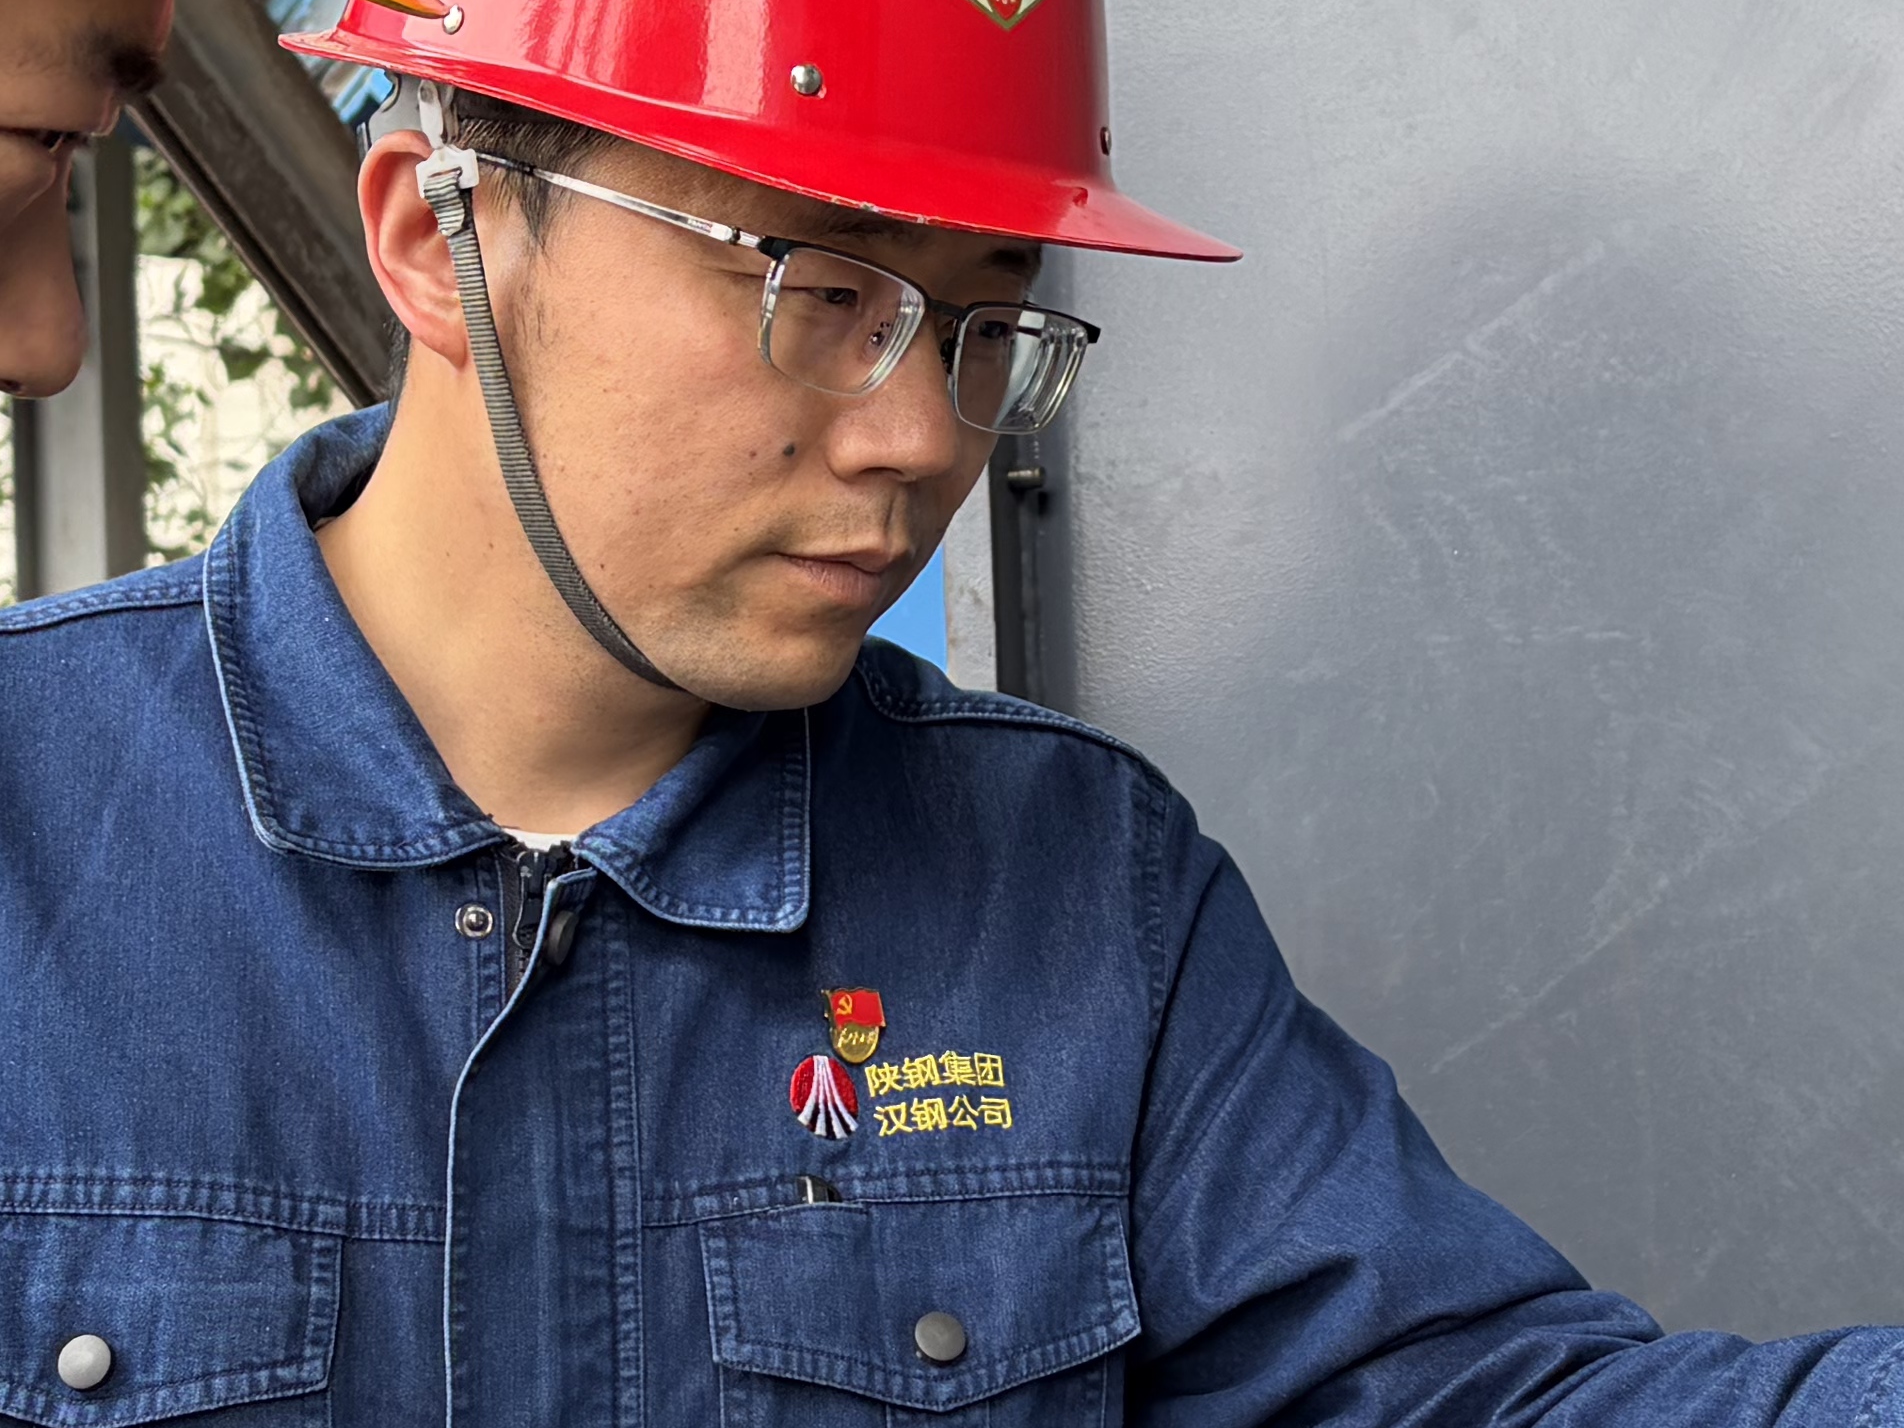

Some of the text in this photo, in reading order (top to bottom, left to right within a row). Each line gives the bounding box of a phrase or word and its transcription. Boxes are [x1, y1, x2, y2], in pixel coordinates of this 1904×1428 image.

[864, 1050, 1005, 1098] 陕钢集团
[873, 1094, 1013, 1137] 汉钢公司
